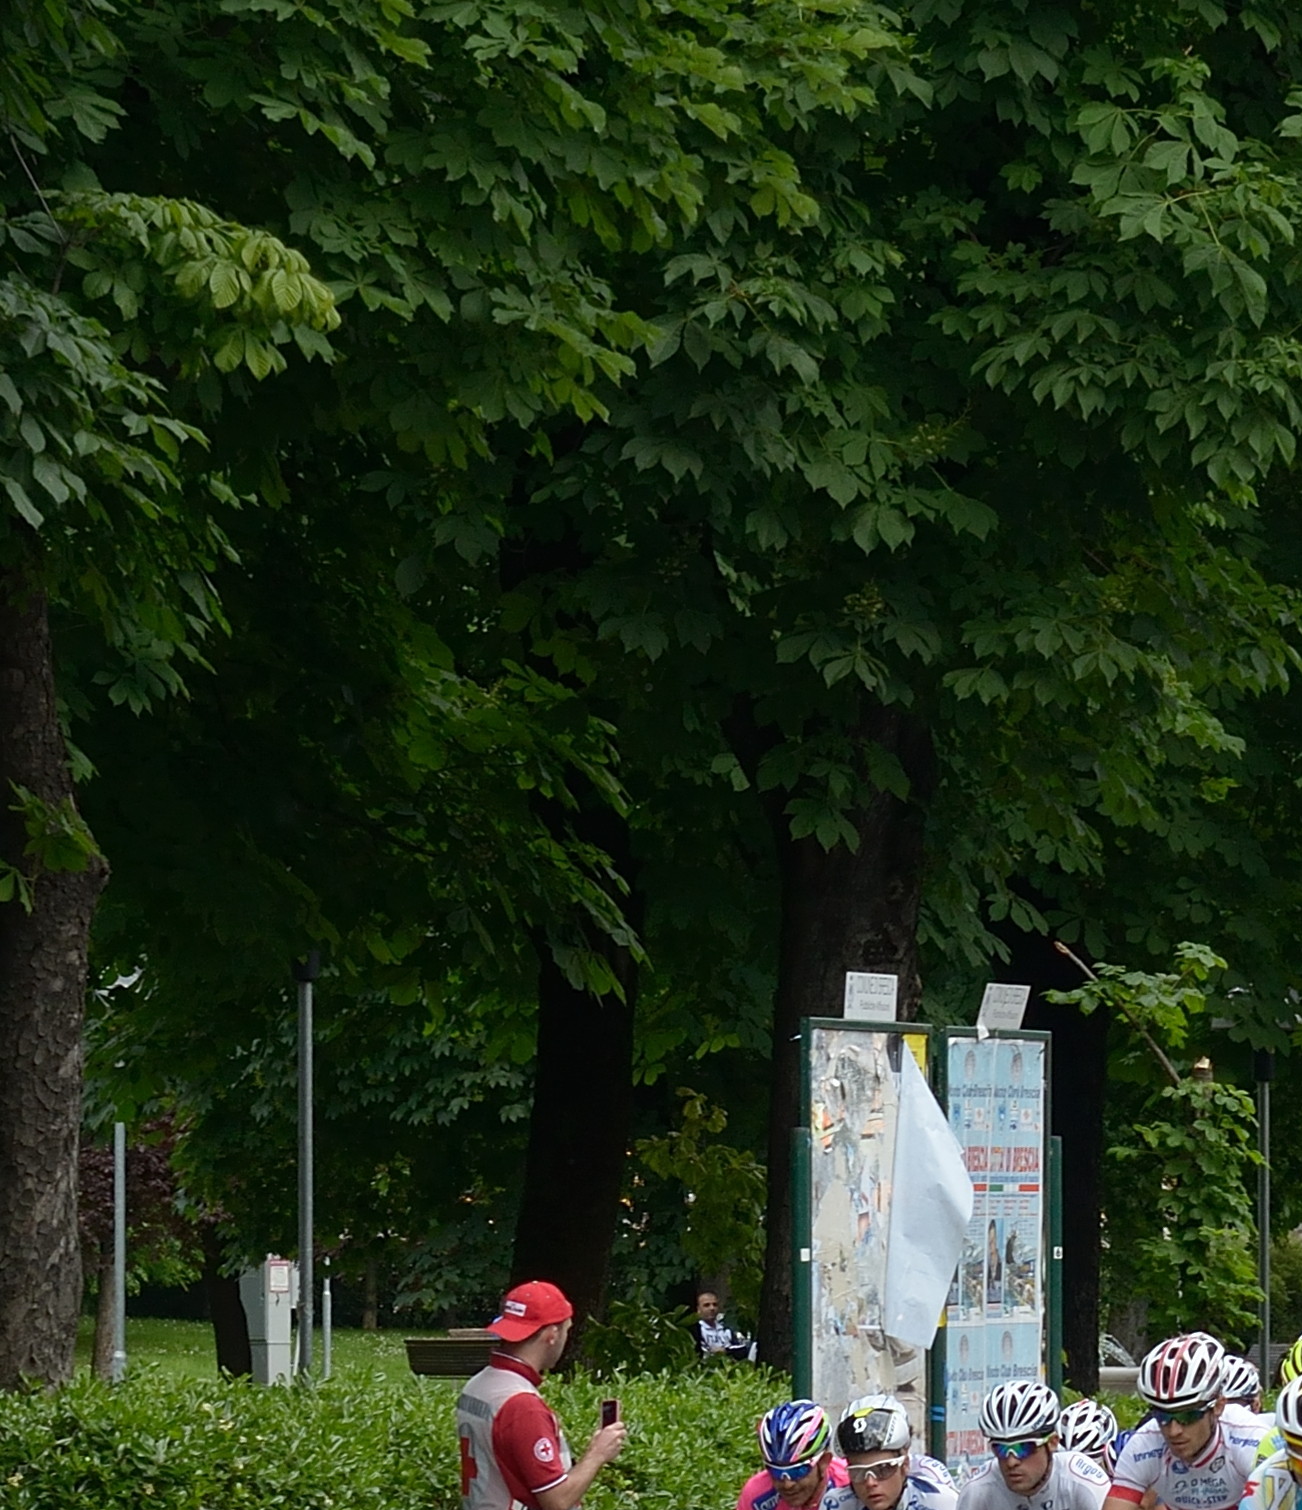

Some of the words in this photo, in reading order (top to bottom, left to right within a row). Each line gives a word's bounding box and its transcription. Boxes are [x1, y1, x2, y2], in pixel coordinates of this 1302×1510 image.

[1013, 1364, 1038, 1378] Brescia
[1075, 1457, 1104, 1479] Argos
[1191, 1477, 1227, 1487] OMEGA
